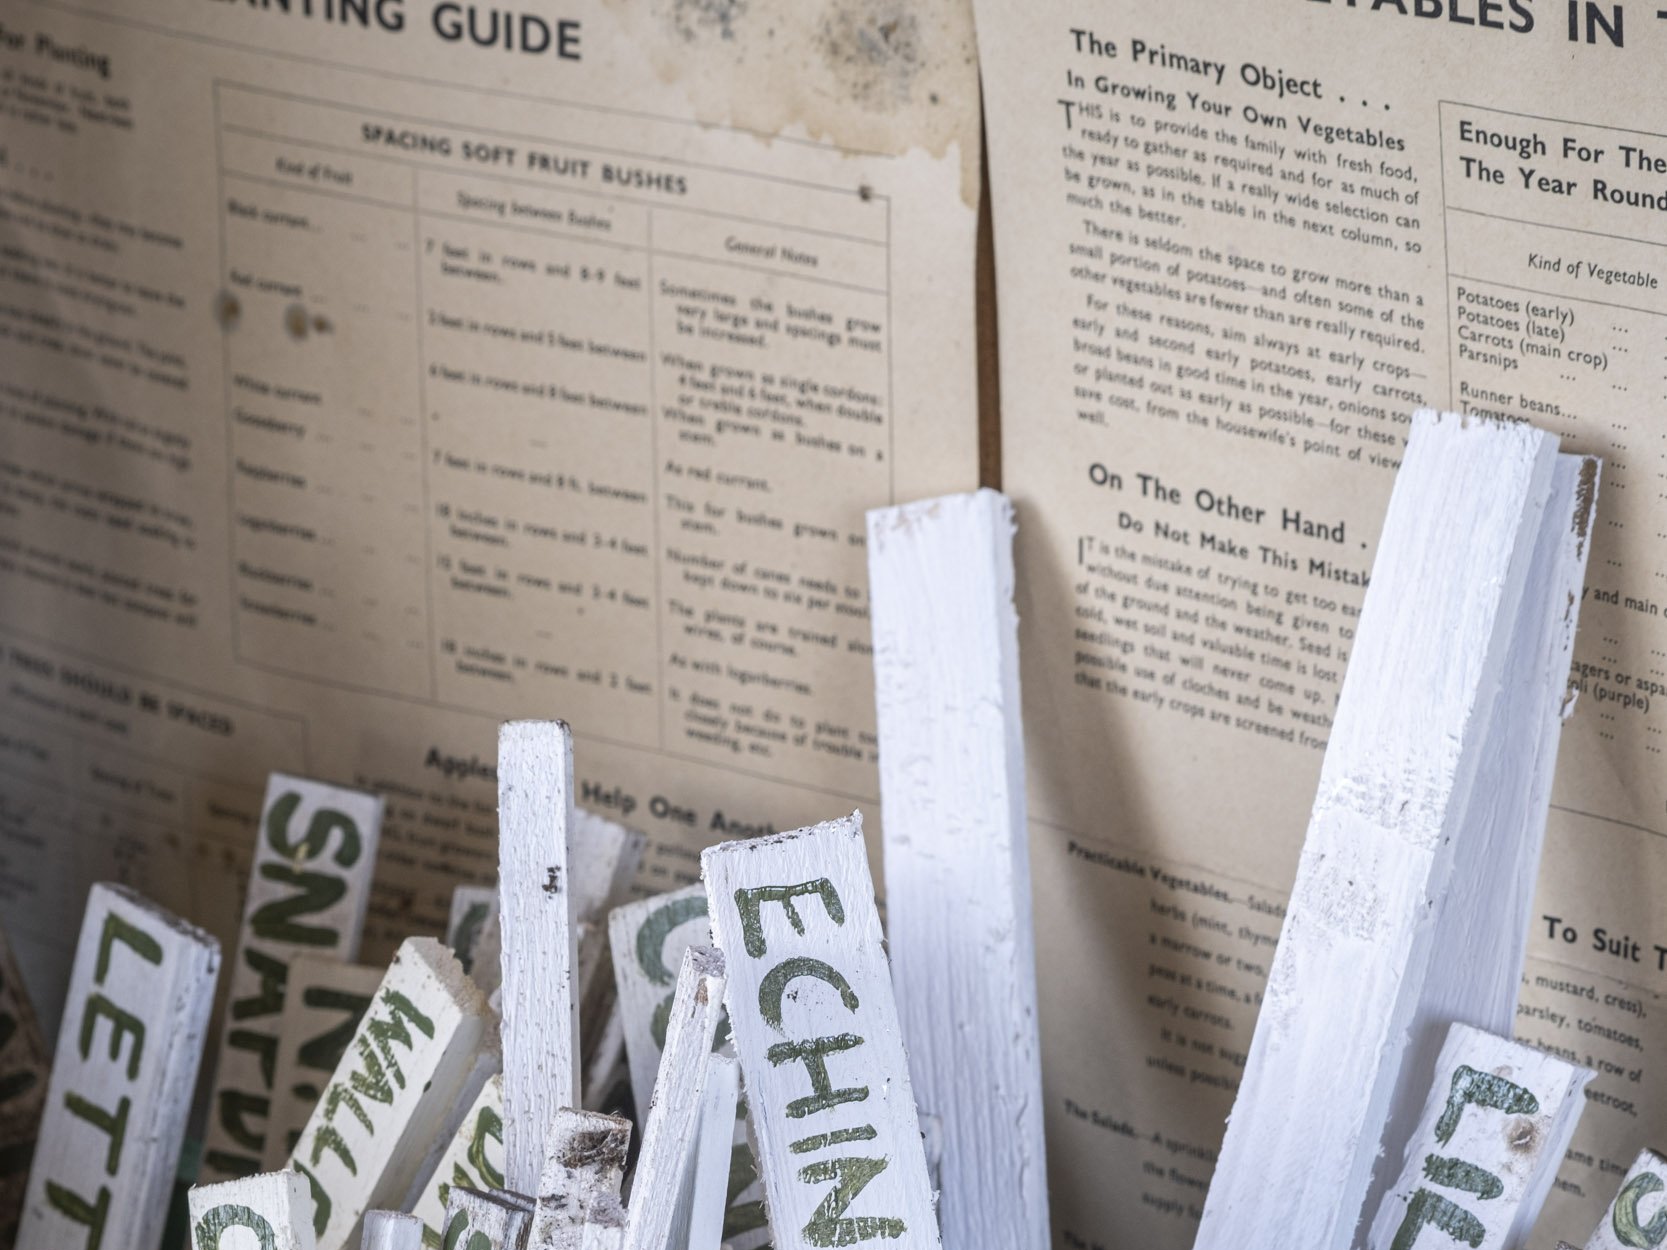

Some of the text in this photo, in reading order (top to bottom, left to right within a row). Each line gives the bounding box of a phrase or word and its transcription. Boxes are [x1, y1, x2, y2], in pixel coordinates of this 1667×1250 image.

[431, 2, 582, 61] GUIDE
[1567, 0, 1623, 48] IN
[1069, 28, 1323, 100] The Primary Object
[1066, 69, 1405, 152] In Growing Your Own Vegetables
[361, 123, 688, 196] SPACING SOFT FRUIT BUSHES
[1080, 128, 1420, 206] ready to gather as required and for as much of
[1109, 109, 1121, 123] is
[1129, 114, 1146, 128] to
[1154, 119, 1208, 140] provide
[1214, 130, 1238, 146] the
[1244, 134, 1286, 159] family
[1293, 148, 1327, 165] with
[1336, 152, 1373, 174] fresh
[1379, 160, 1418, 184] food,
[1459, 120, 1667, 174] Enough For The
[1061, 145, 1421, 230] the year as possible. If a really wide selection can
[1459, 156, 1667, 212] The Year Round
[1064, 166, 1422, 254] be grown, as in the table in the next column, so
[1527, 252, 1658, 290] Kind of Vegetable
[1457, 287, 1575, 326] Potatoes (early)
[1457, 306, 1566, 344] Potatoes (late)
[1457, 326, 1608, 370] Carrots (main crop)
[1458, 344, 1519, 371] Parsnips
[1460, 382, 1514, 406] Runner
[1088, 463, 1345, 545] On The Other Hand
[1118, 512, 1144, 534] Do
[1154, 520, 1189, 545] Not
[1199, 531, 1249, 560] Make
[1258, 545, 1298, 572] This
[1593, 588, 1658, 616] and main
[1593, 683, 1650, 714] (purple)
[580, 780, 637, 816] Help
[648, 795, 697, 827] One
[1542, 916, 1578, 945] To
[1592, 929, 1641, 963] Suit
[1583, 1084, 1637, 1117] eetroot,
